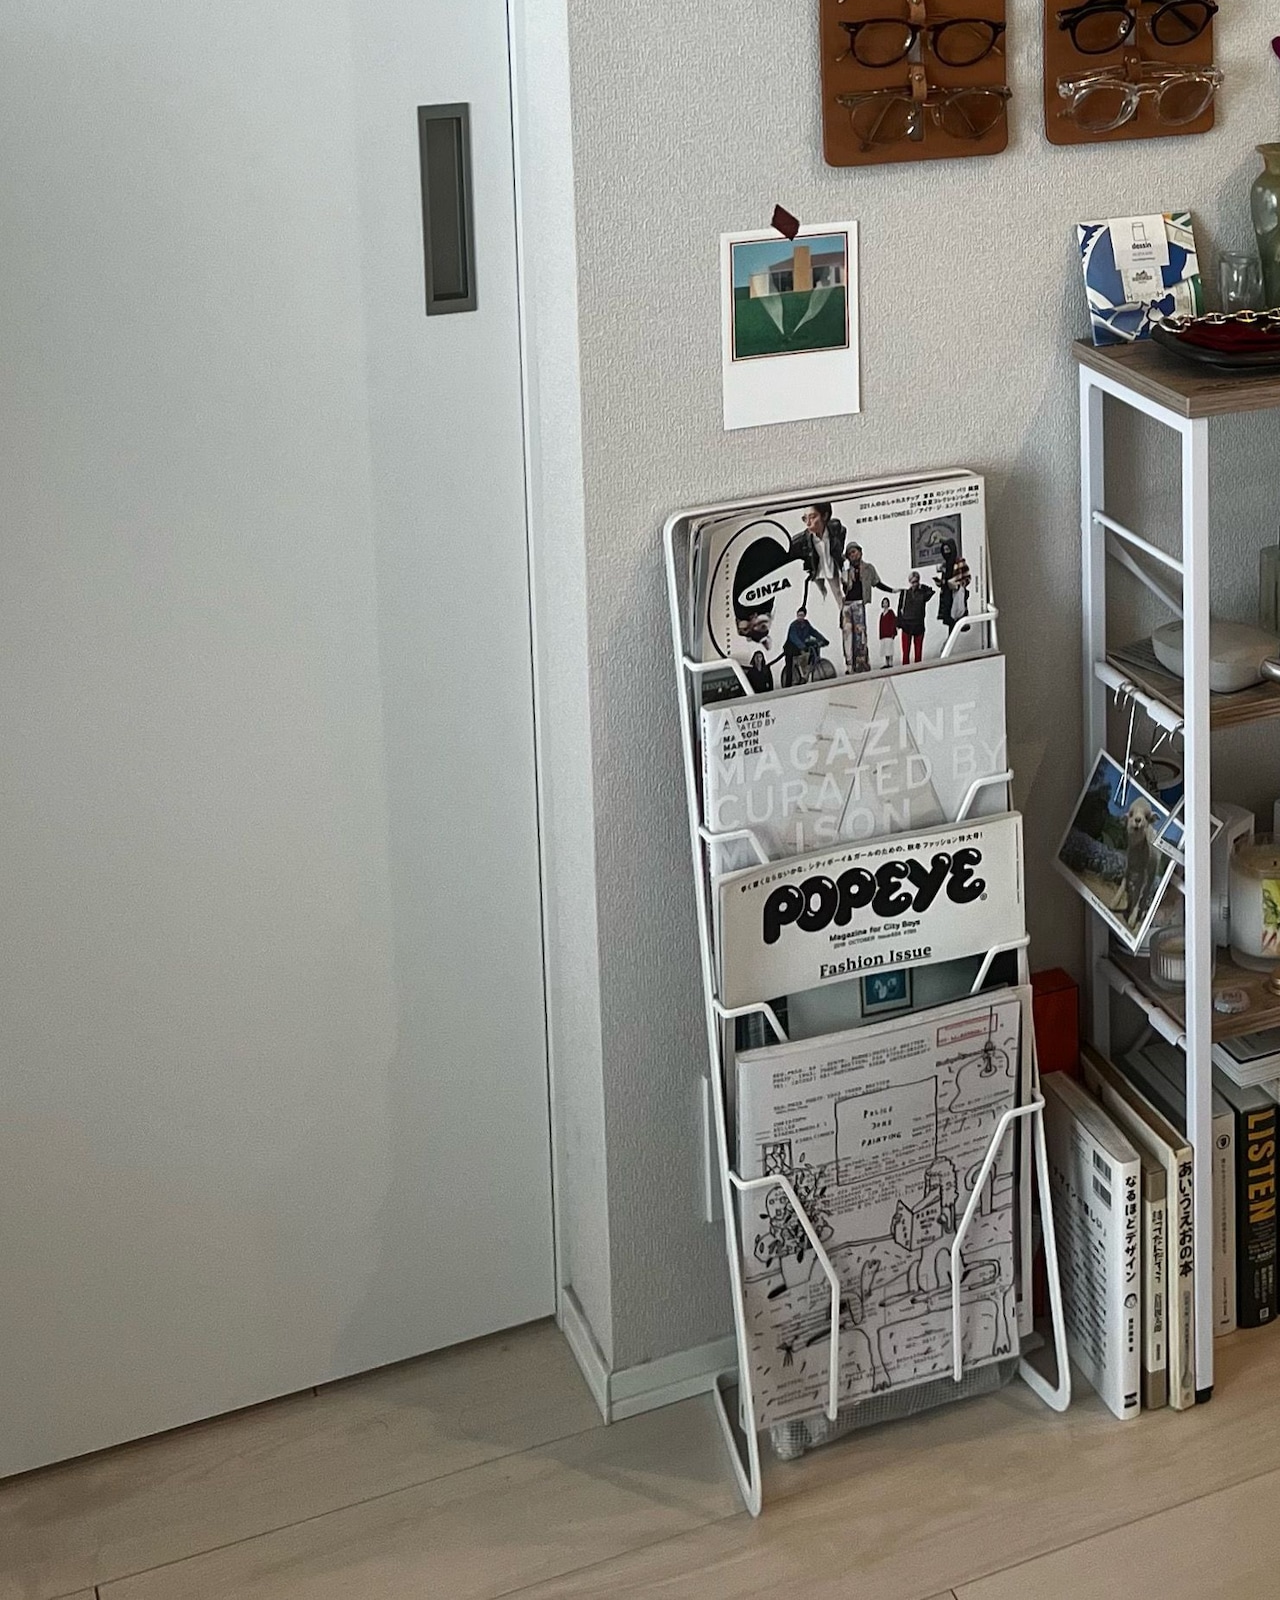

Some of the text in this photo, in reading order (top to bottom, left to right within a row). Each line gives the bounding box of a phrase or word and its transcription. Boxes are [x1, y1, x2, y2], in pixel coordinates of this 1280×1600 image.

[1131, 242, 1152, 250] dessin
[745, 578, 792, 602] GINZA
[716, 701, 979, 790] MAGAZINE
[716, 739, 1007, 832] CURATED BY
[723, 739, 760, 751] MARTIN
[762, 847, 986, 945] POPEYE
[829, 928, 868, 941] Magazine
[869, 926, 882, 935] for
[883, 922, 901, 932] City
[901, 919, 921, 929] Boys
[819, 945, 932, 978] Fashion Issue
[1248, 1107, 1276, 1224] LISTEN
[1124, 1175, 1138, 1283] なるほどデザイン
[1178, 1161, 1194, 1278] あいうえおの本
